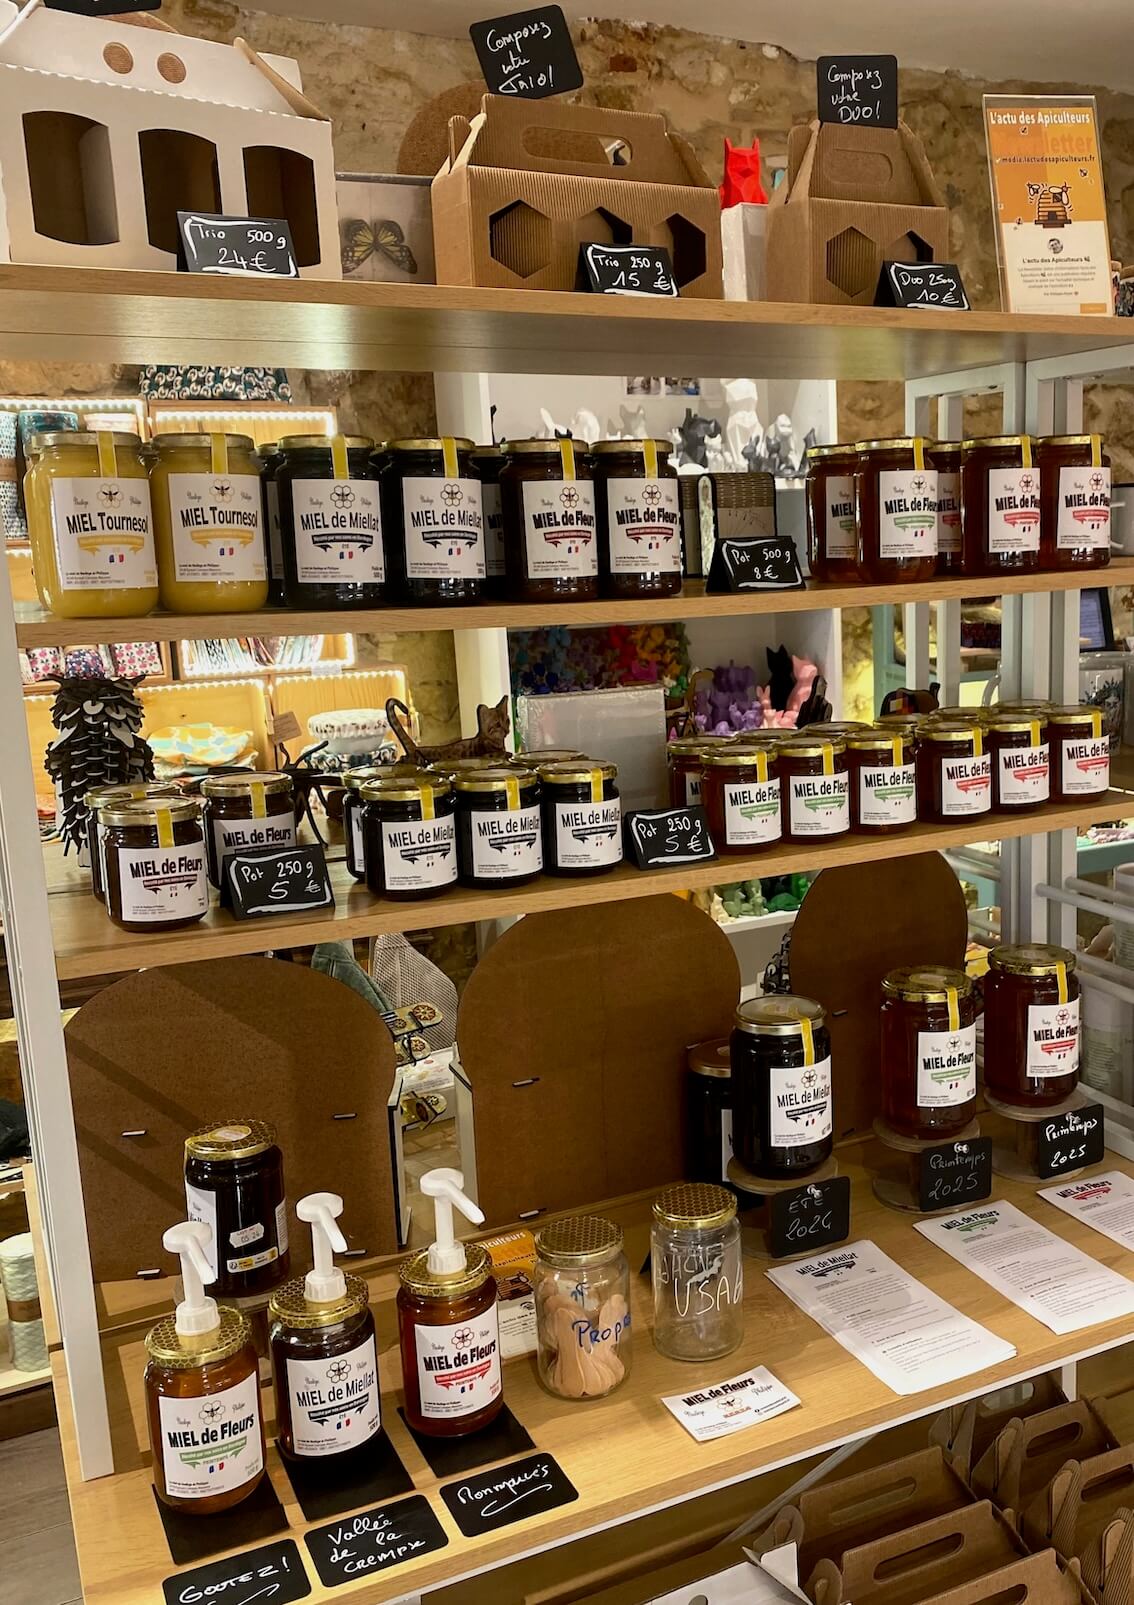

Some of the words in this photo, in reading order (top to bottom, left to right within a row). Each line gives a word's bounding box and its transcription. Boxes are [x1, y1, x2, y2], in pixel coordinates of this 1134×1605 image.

[837, 103, 881, 123] DUO!
[990, 111, 1017, 124] L'actu
[1019, 111, 1035, 124] des
[1037, 111, 1090, 127] Apiculteurs
[190, 224, 226, 239] Trio
[247, 230, 274, 243] 500
[276, 236, 286, 249] g
[593, 255, 619, 267] Trio
[630, 256, 650, 268] 250
[655, 261, 663, 275] g
[612, 271, 640, 286] 15
[653, 276, 671, 290] €
[899, 272, 923, 285] Duo
[884, 499, 910, 515] MIEL
[910, 498, 922, 511] de
[995, 496, 1019, 511] MIEL
[1019, 494, 1030, 508] de
[1065, 495, 1087, 508] MIEL
[1089, 493, 1099, 506] de
[66, 513, 97, 534] MIEL
[98, 512, 149, 534] Tournesol
[180, 507, 208, 528] MIEL
[209, 507, 258, 528] Tournesol
[300, 513, 329, 531] MIEL
[331, 512, 347, 529] de
[350, 512, 379, 532] Miellat
[411, 511, 439, 528] MIEL
[441, 510, 456, 527] de
[532, 512, 561, 529] MIEL
[562, 511, 575, 526] de
[616, 510, 642, 525] MIEL
[644, 508, 656, 522] de
[731, 549, 751, 565] Pot
[763, 550, 782, 561] 500
[785, 549, 791, 564] g
[1003, 754, 1026, 769] MIEL
[1028, 752, 1038, 766] de
[1067, 746, 1089, 760] MIEL
[1091, 744, 1100, 757] de
[864, 773, 888, 788] MIEL
[890, 771, 901, 785] de
[946, 766, 967, 780] MIEL
[970, 763, 981, 776] de
[729, 791, 754, 806] MIEL
[756, 788, 767, 802] de
[794, 782, 819, 798] MIEL
[820, 781, 832, 796] de
[477, 821, 504, 837] MIEL
[505, 818, 519, 832] de
[561, 811, 588, 828] MIEL
[588, 809, 601, 825] de
[637, 823, 657, 839] Pot
[667, 817, 691, 832] 250
[694, 819, 702, 835] g
[223, 831, 250, 848] MIEL
[250, 828, 264, 843] de
[266, 827, 291, 842] Fleurs
[388, 832, 417, 849] MIEL
[417, 829, 431, 844] de
[664, 836, 680, 852] 5
[687, 835, 703, 852] €
[129, 862, 160, 879] MIEL
[163, 858, 176, 874] de
[179, 856, 203, 873] Fleurs
[241, 866, 264, 883] Pot
[277, 862, 302, 878] 250
[306, 862, 314, 879] g
[268, 881, 290, 900] 5
[304, 880, 321, 893] €
[1033, 1028, 1054, 1042] MIEL
[1056, 1026, 1065, 1039] de
[923, 1055, 945, 1070] MIEL
[946, 1054, 957, 1068] de
[777, 1093, 799, 1108] MIEL
[801, 1091, 812, 1105] de
[930, 1151, 986, 1171] Printemps
[1050, 1145, 1086, 1168] 2025
[928, 1172, 979, 1200] 2025
[1056, 1187, 1077, 1199] MIEL
[1077, 1185, 1087, 1194] de
[1087, 1180, 1112, 1192] Fleurs
[941, 1220, 963, 1231] MIEL
[963, 1216, 973, 1225] de
[973, 1209, 1000, 1222] Fleurs
[796, 1262, 819, 1277] MIEL
[819, 1258, 829, 1269] de
[828, 1252, 858, 1267] Miellat
[423, 1356, 452, 1371] MIEL
[454, 1352, 468, 1367] de
[470, 1339, 496, 1362] Fleurs
[296, 1390, 326, 1407] MIEL
[328, 1387, 343, 1402] de
[346, 1371, 374, 1396] Miellat
[683, 1390, 710, 1407] MIEL
[709, 1387, 720, 1398] de
[720, 1376, 754, 1394] Fleurs
[168, 1431, 199, 1448] MIEL
[201, 1427, 218, 1444] de
[220, 1414, 254, 1440] Fleurs
[328, 1514, 392, 1545] Vallée
[330, 1548, 357, 1562] de
[376, 1532, 402, 1545] la
